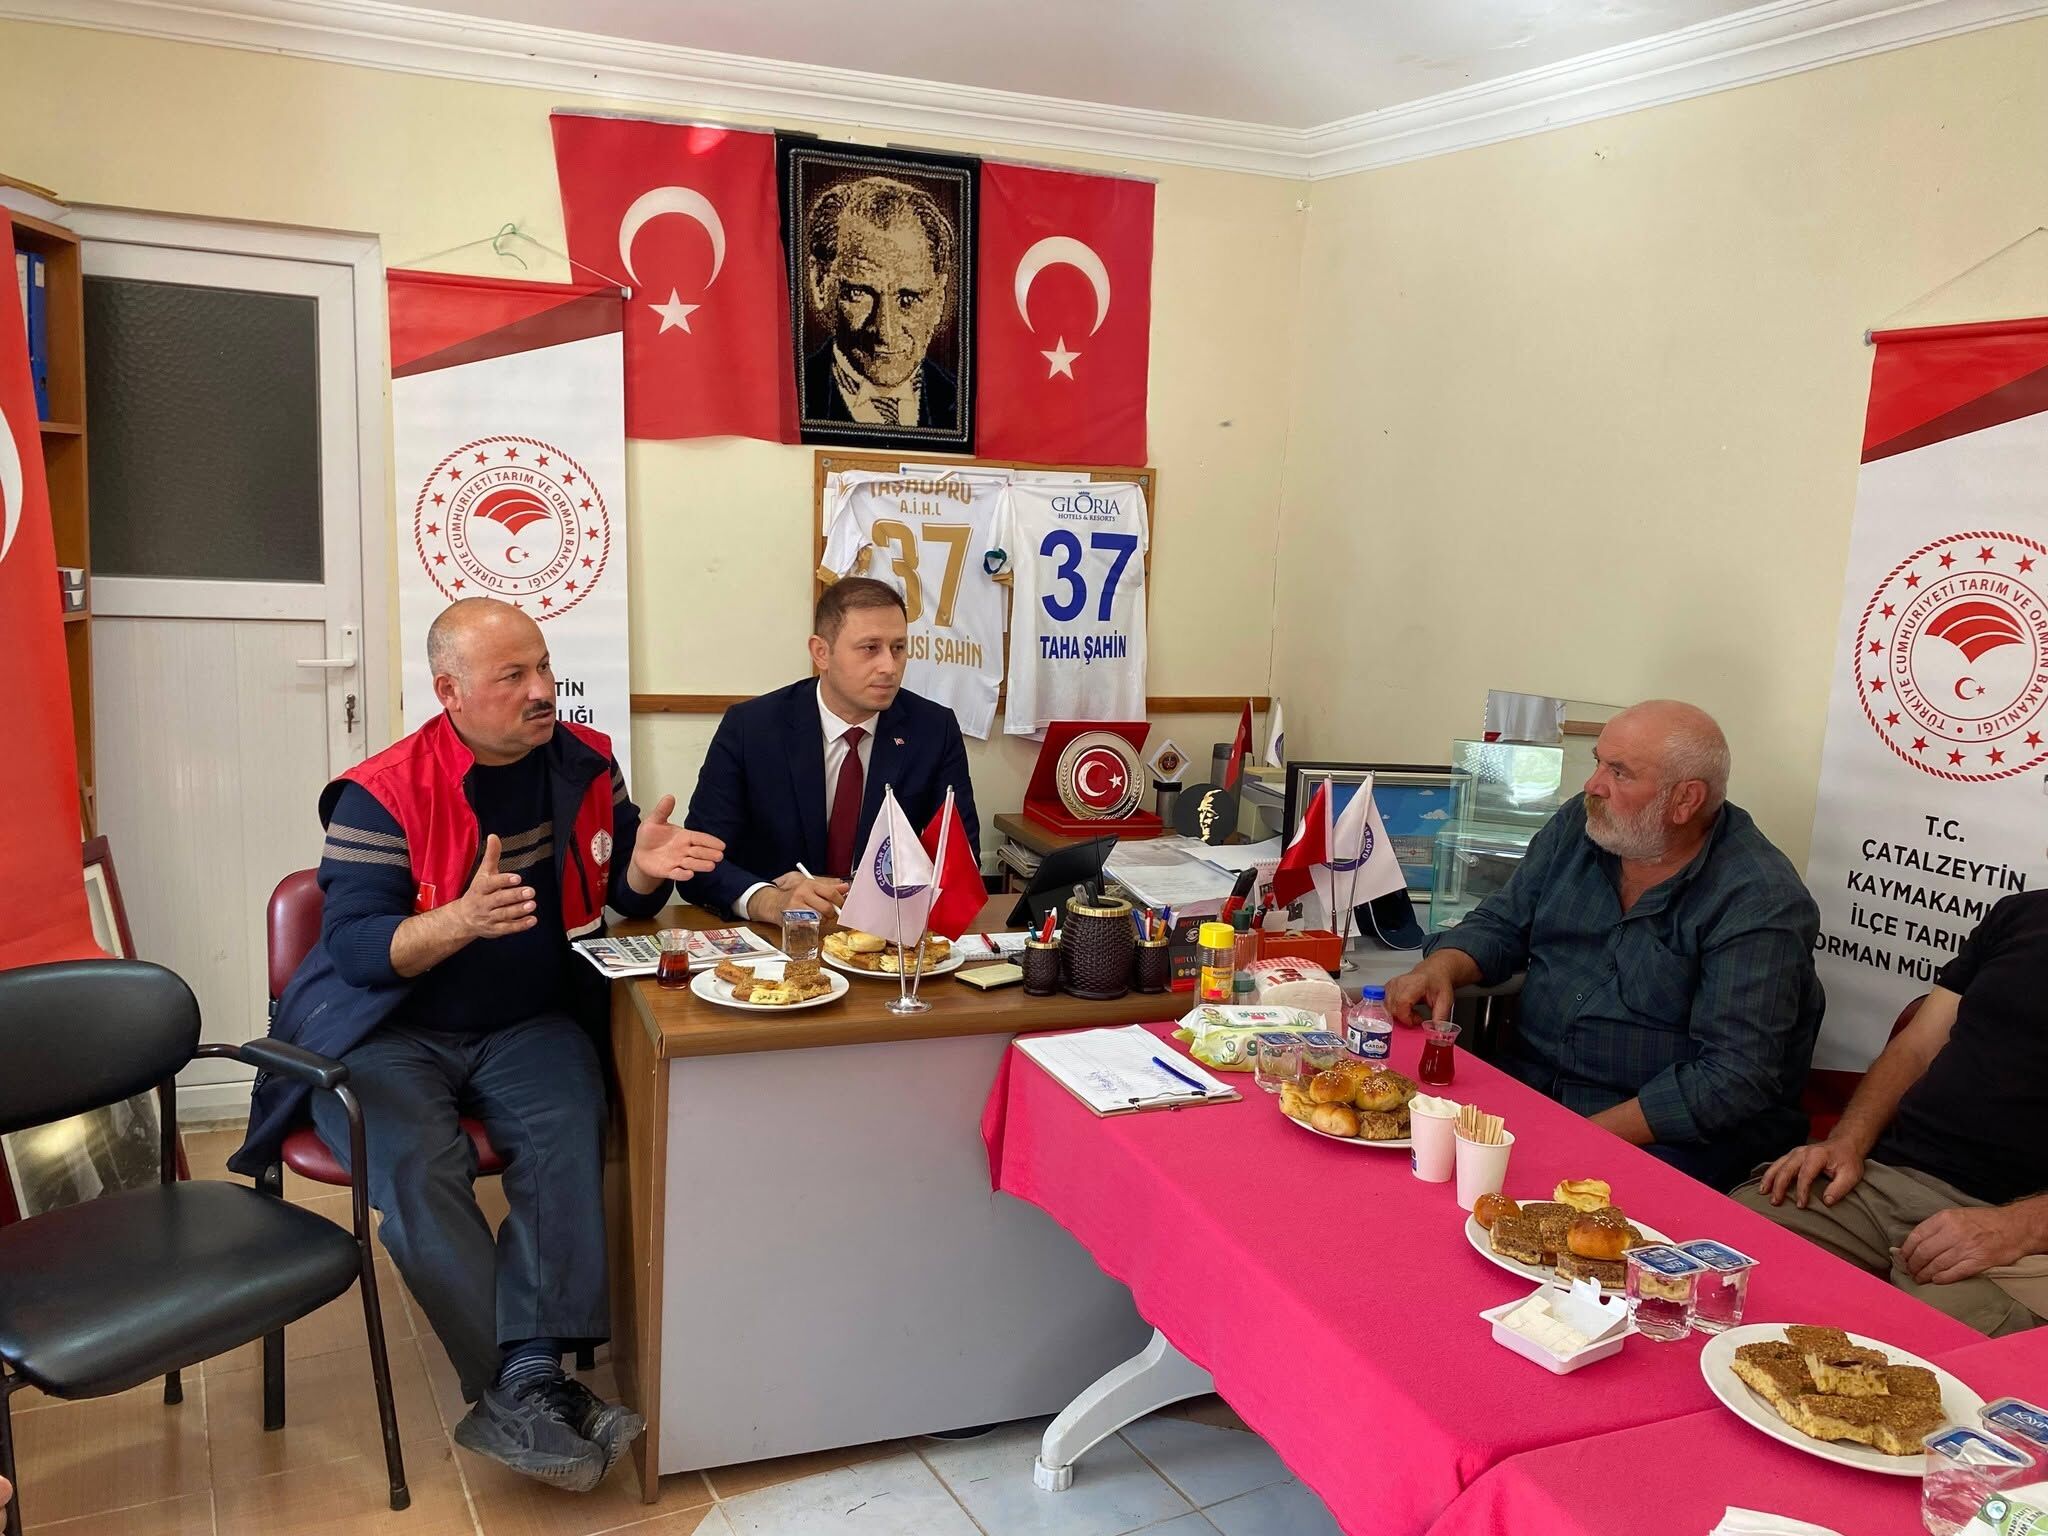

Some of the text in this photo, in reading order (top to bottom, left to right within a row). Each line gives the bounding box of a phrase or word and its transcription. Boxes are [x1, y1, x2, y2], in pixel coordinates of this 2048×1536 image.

[1051, 494, 1120, 515] GLORIA
[1058, 512, 1082, 520] HOTELS
[1089, 514, 1116, 522] RESORTS
[452, 471, 575, 589] TÜRKİYE CUMHURİYETİ TARIM VE ORMAN BAKANLIĞI
[872, 518, 973, 628] 37
[1039, 529, 1139, 622] 37
[1959, 578, 2009, 596] TARIM
[2012, 589, 2032, 610] VE
[1896, 580, 1955, 674] CUMHURİYETİ
[934, 635, 983, 669] ŞAHİN
[1040, 630, 1127, 665] TAHA ŞAHİN
[1899, 678, 1946, 731] TÜRKİYE
[1977, 673, 2048, 737] BAKANLIĞI
[1925, 815, 1966, 843] T.C.
[1861, 838, 2027, 893] ÇATALZEYTİN
[1850, 902, 1899, 937] İLÇE
[1814, 931, 1892, 971] ORMAN
